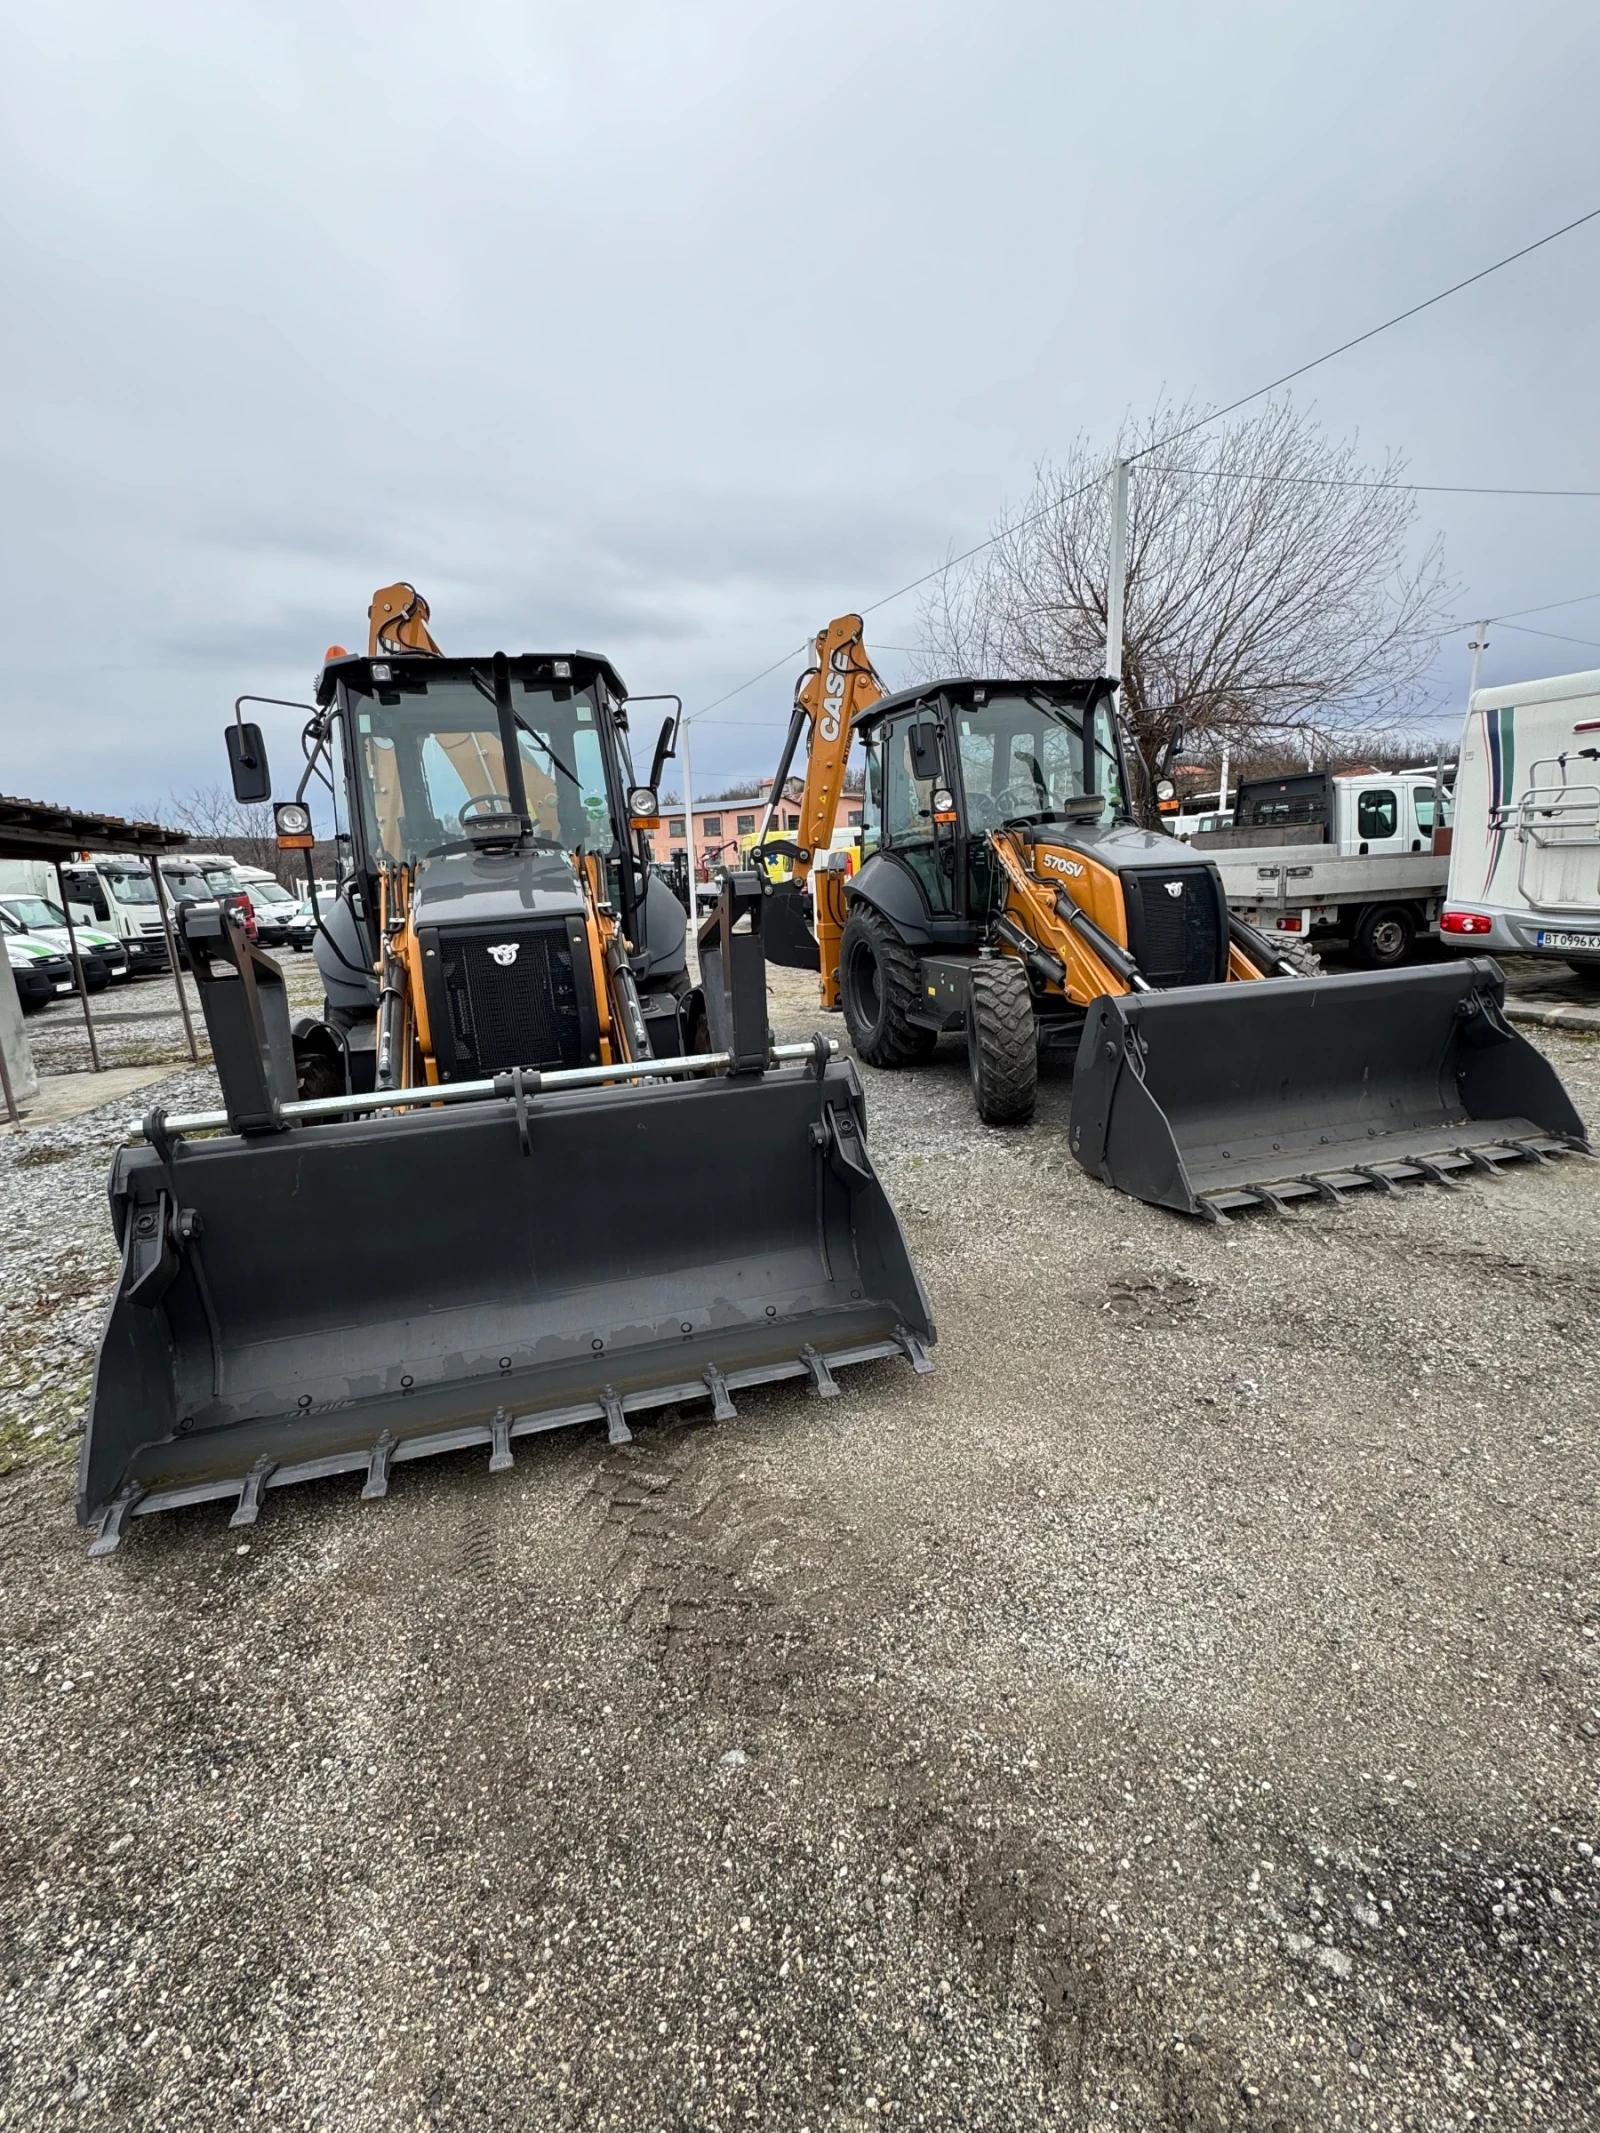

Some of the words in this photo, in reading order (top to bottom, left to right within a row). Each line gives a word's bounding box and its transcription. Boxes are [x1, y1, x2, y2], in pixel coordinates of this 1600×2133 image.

[820, 648, 849, 742] CASE
[1043, 853, 1084, 878] 570SV
[1545, 934, 1559, 944] BT
[1560, 935, 1587, 946] 0996
